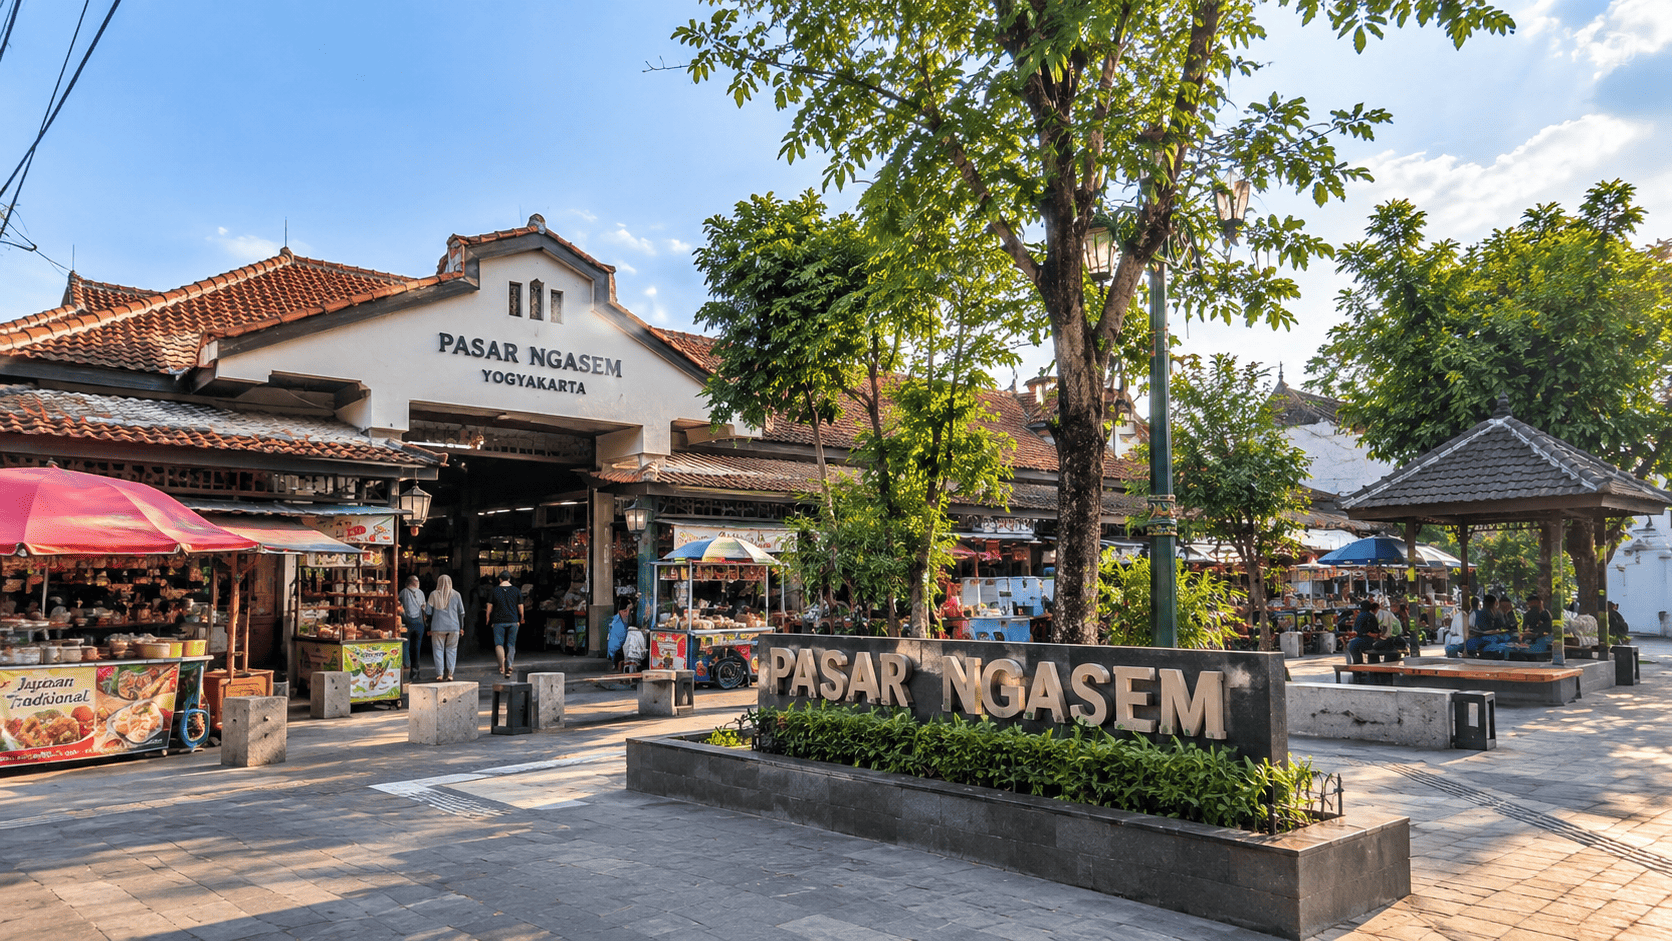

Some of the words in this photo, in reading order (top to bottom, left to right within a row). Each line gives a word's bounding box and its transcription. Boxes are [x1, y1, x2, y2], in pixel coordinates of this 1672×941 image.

[438, 332, 519, 363] PASAR
[529, 346, 622, 378] NGASEM
[482, 369, 586, 394] YOGYAKARTA
[769, 647, 914, 708] PASAR
[942, 655, 1227, 740] NGASEM
